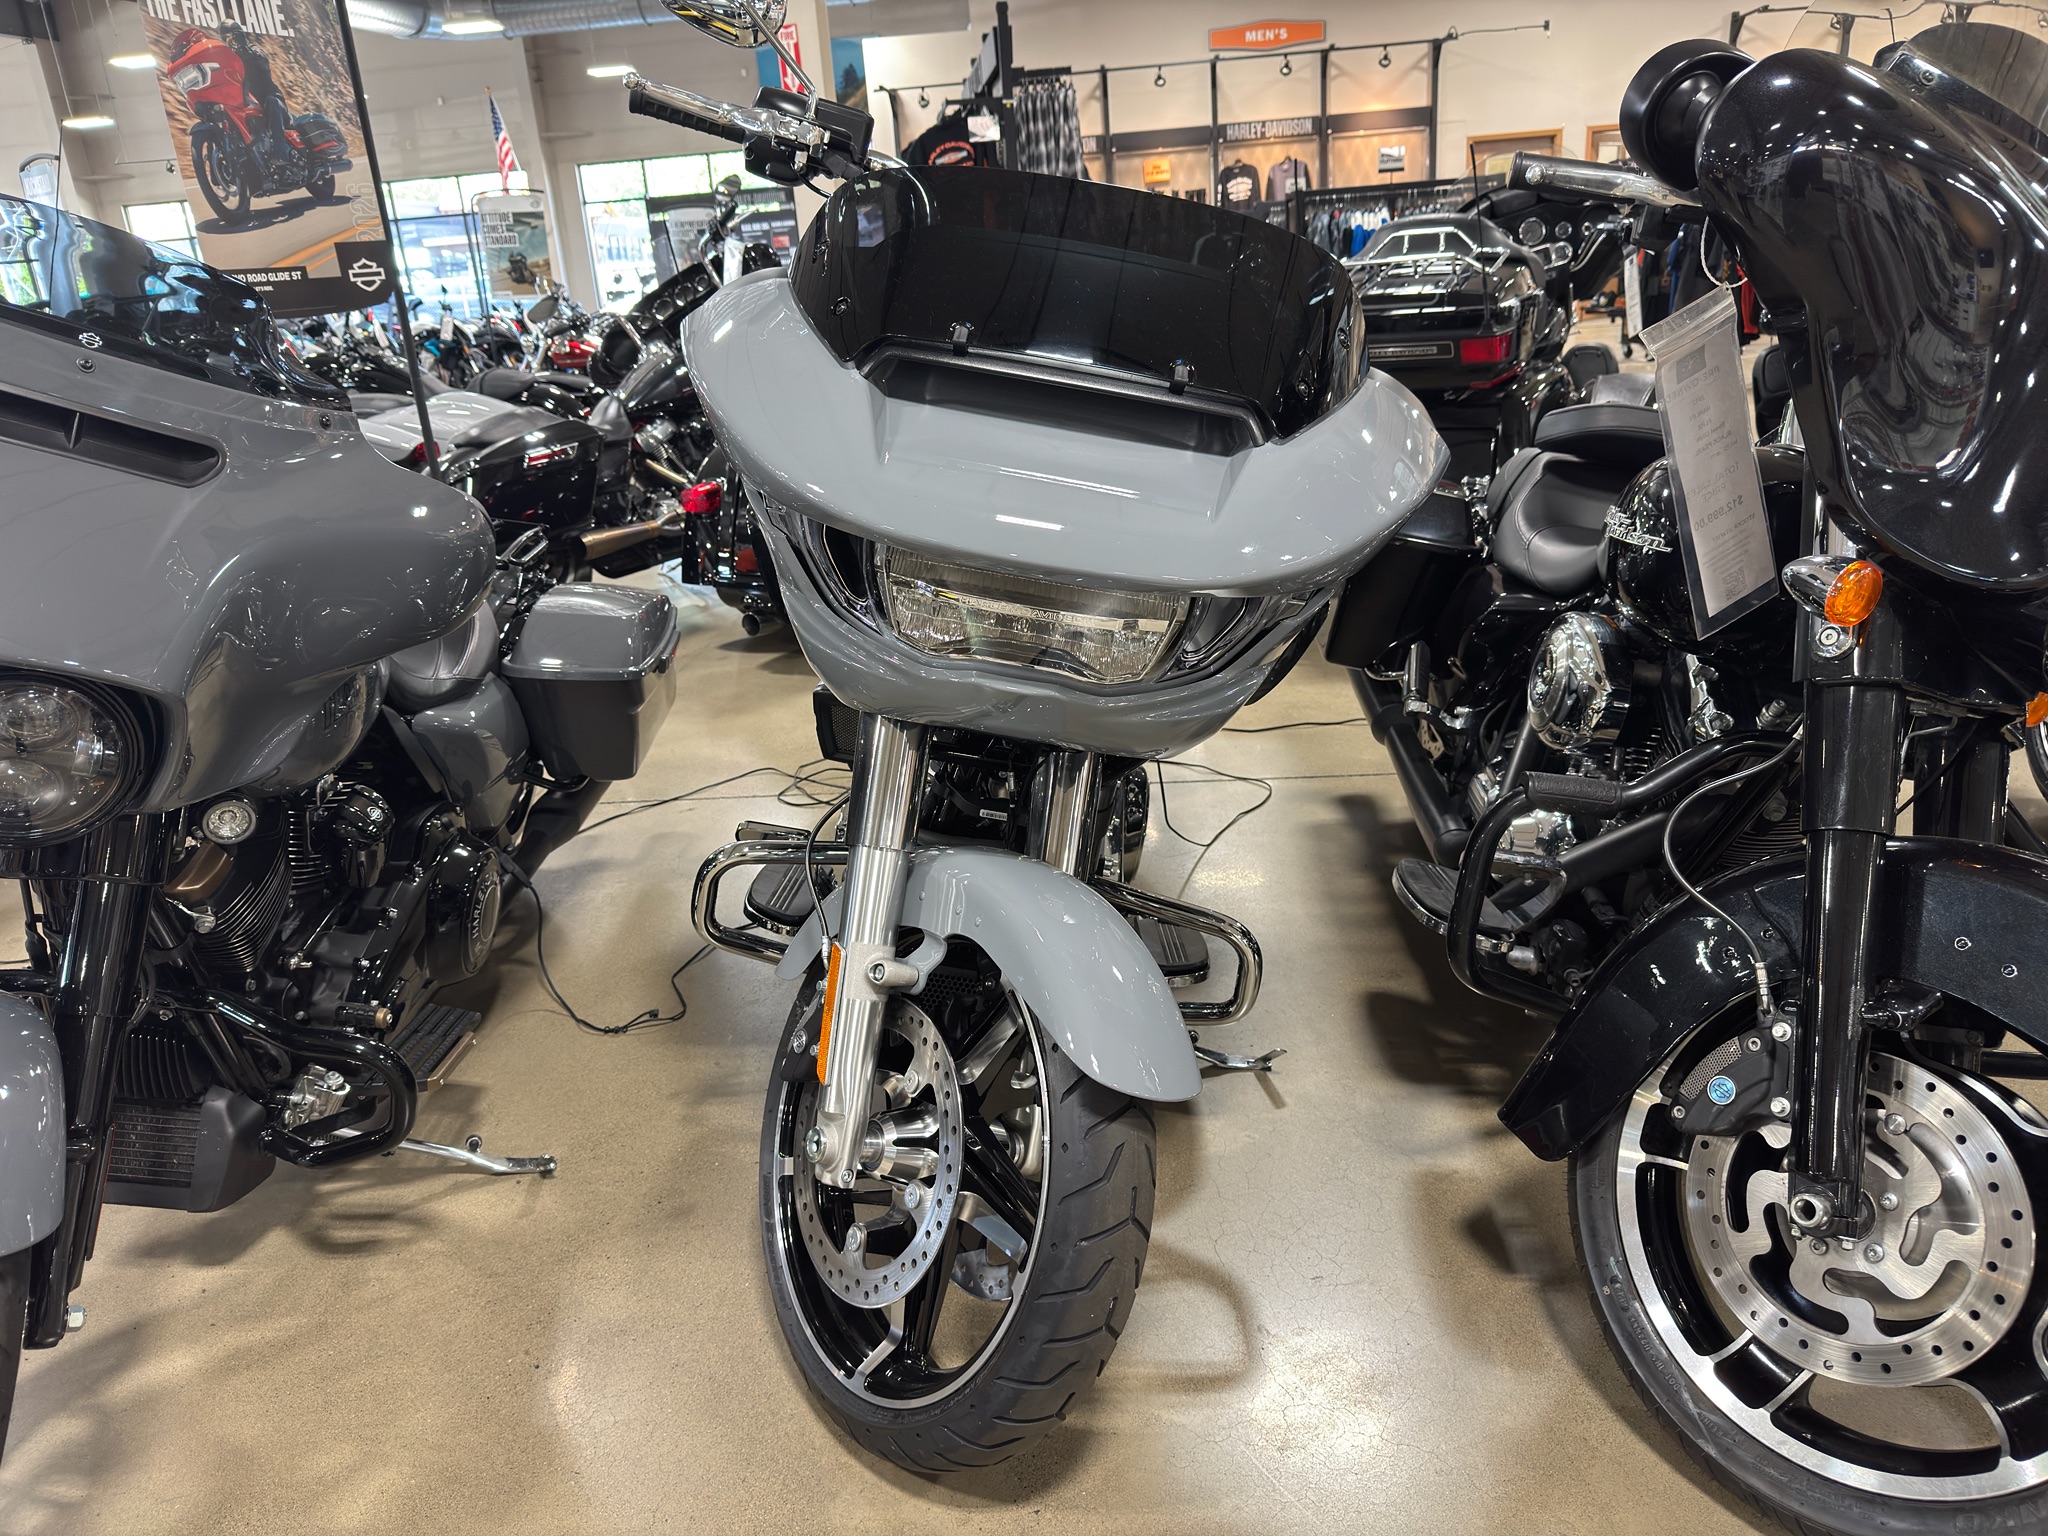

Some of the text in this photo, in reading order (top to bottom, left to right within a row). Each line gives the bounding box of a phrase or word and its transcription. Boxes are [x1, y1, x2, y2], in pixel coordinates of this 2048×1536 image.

[1245, 27, 1288, 43] MEN'S
[1226, 117, 1313, 141] HARLEY-DAVIDSON
[247, 273, 267, 283] ROAD
[267, 271, 290, 282] GLIDE
[291, 271, 302, 280] ST
